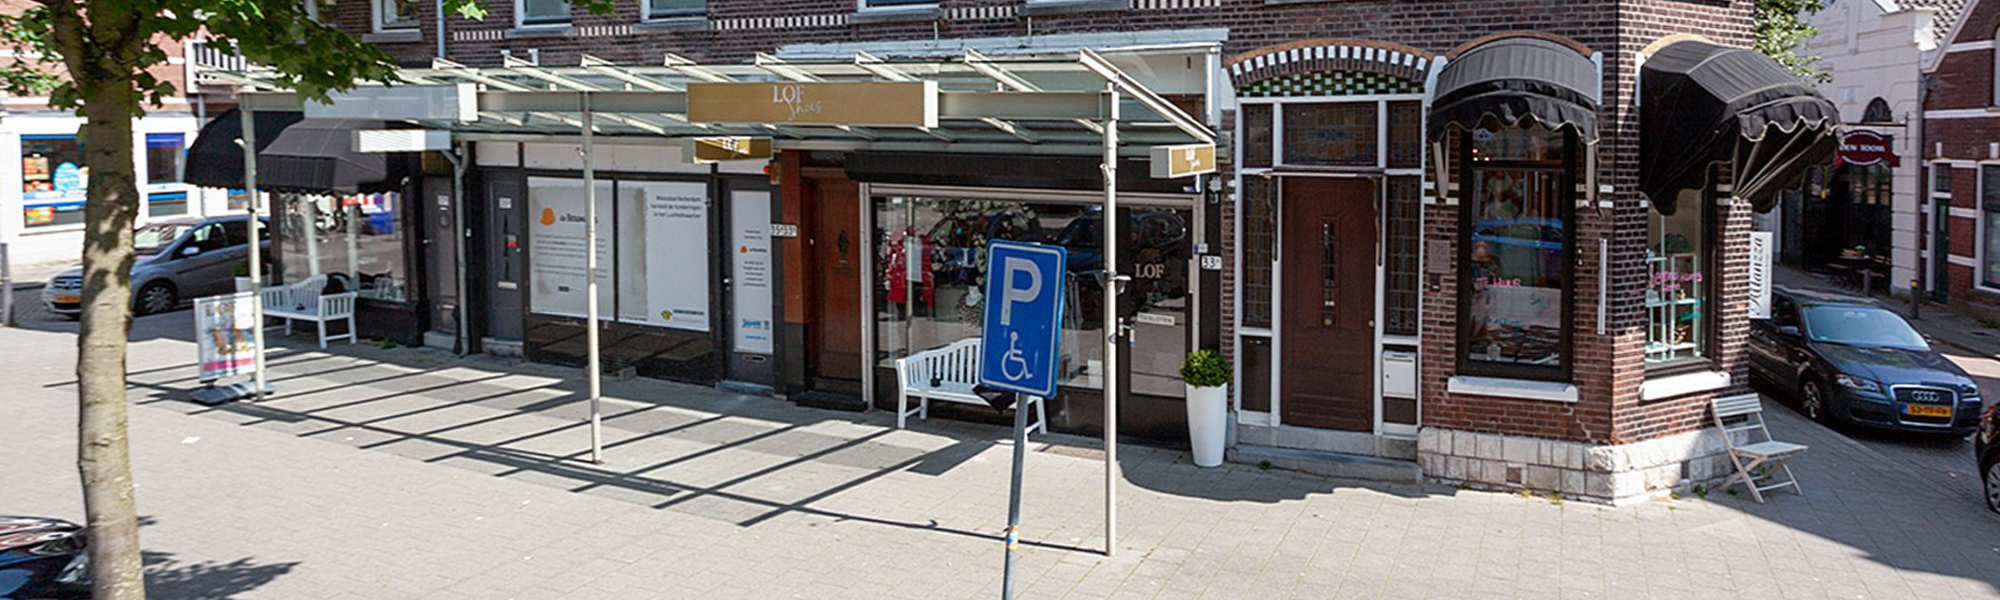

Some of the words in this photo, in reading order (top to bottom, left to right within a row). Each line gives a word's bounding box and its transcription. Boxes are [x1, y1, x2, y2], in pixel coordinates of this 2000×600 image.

[773, 83, 805, 104] LOF
[1134, 262, 1165, 279] LOF
[1001, 256, 1043, 326] P
